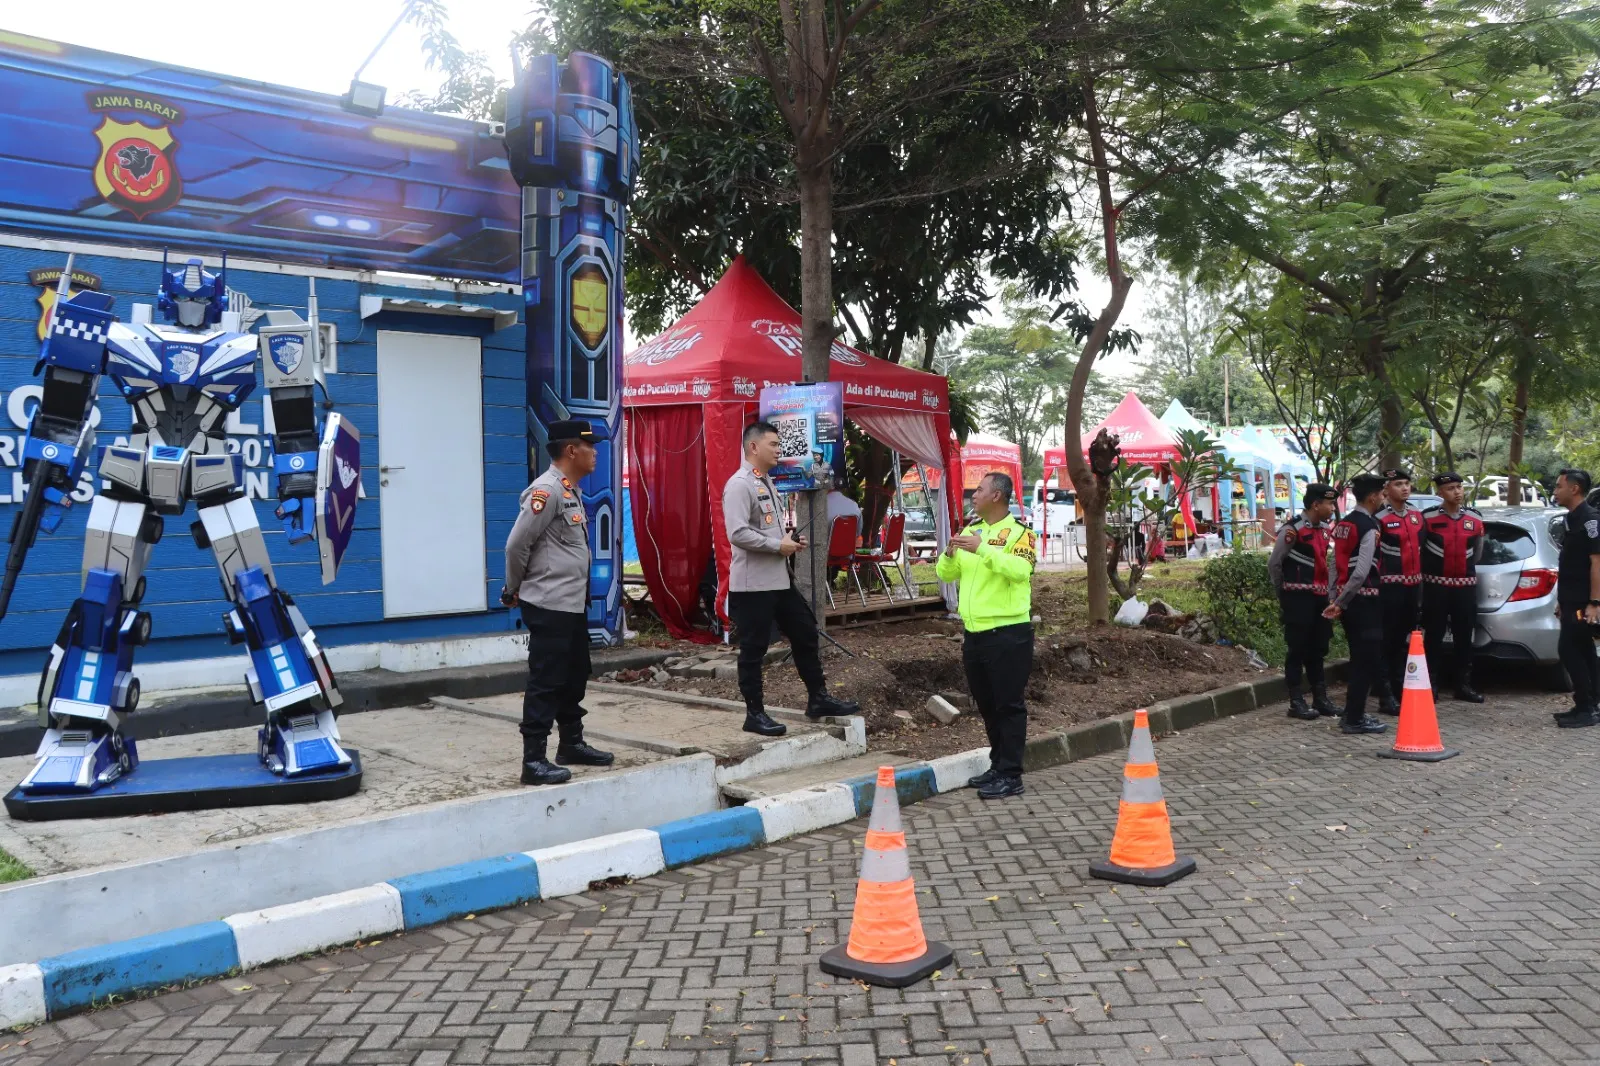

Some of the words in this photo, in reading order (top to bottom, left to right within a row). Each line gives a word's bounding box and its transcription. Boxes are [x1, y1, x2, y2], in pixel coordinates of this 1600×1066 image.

[95, 96, 131, 107] JAWA
[134, 98, 178, 119] BARAT
[638, 384, 645, 395] di
[646, 381, 687, 395] Pucuknya!
[846, 383, 863, 395] Ada
[864, 385, 873, 396] di
[875, 386, 917, 402] Pucuknya!
